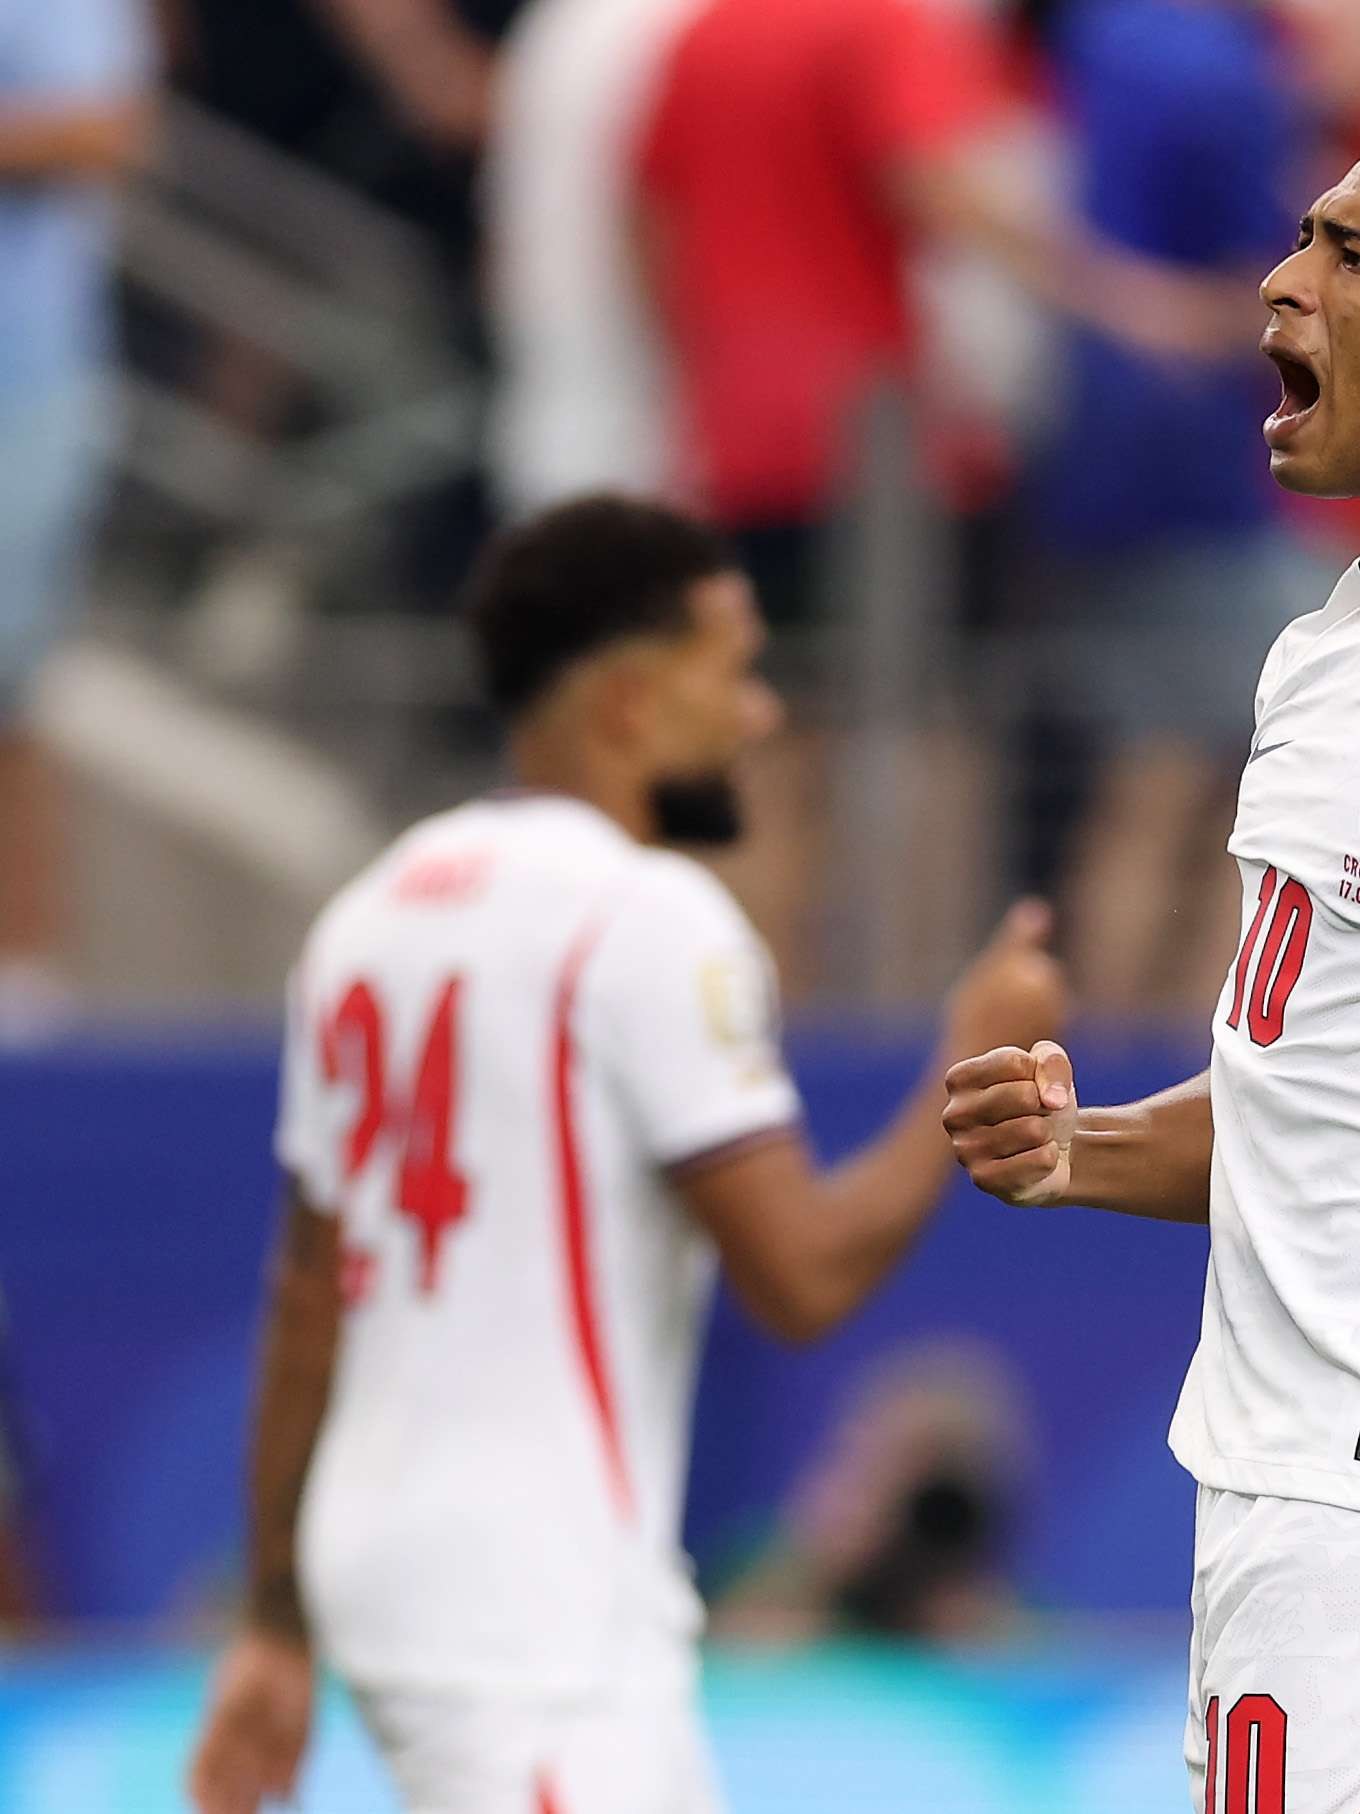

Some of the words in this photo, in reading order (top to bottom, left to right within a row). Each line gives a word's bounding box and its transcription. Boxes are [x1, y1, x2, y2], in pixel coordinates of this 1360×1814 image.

[1226, 864, 1314, 1048] 10
[318, 966, 471, 1304] 24
[1205, 1693, 1288, 1814] 10
